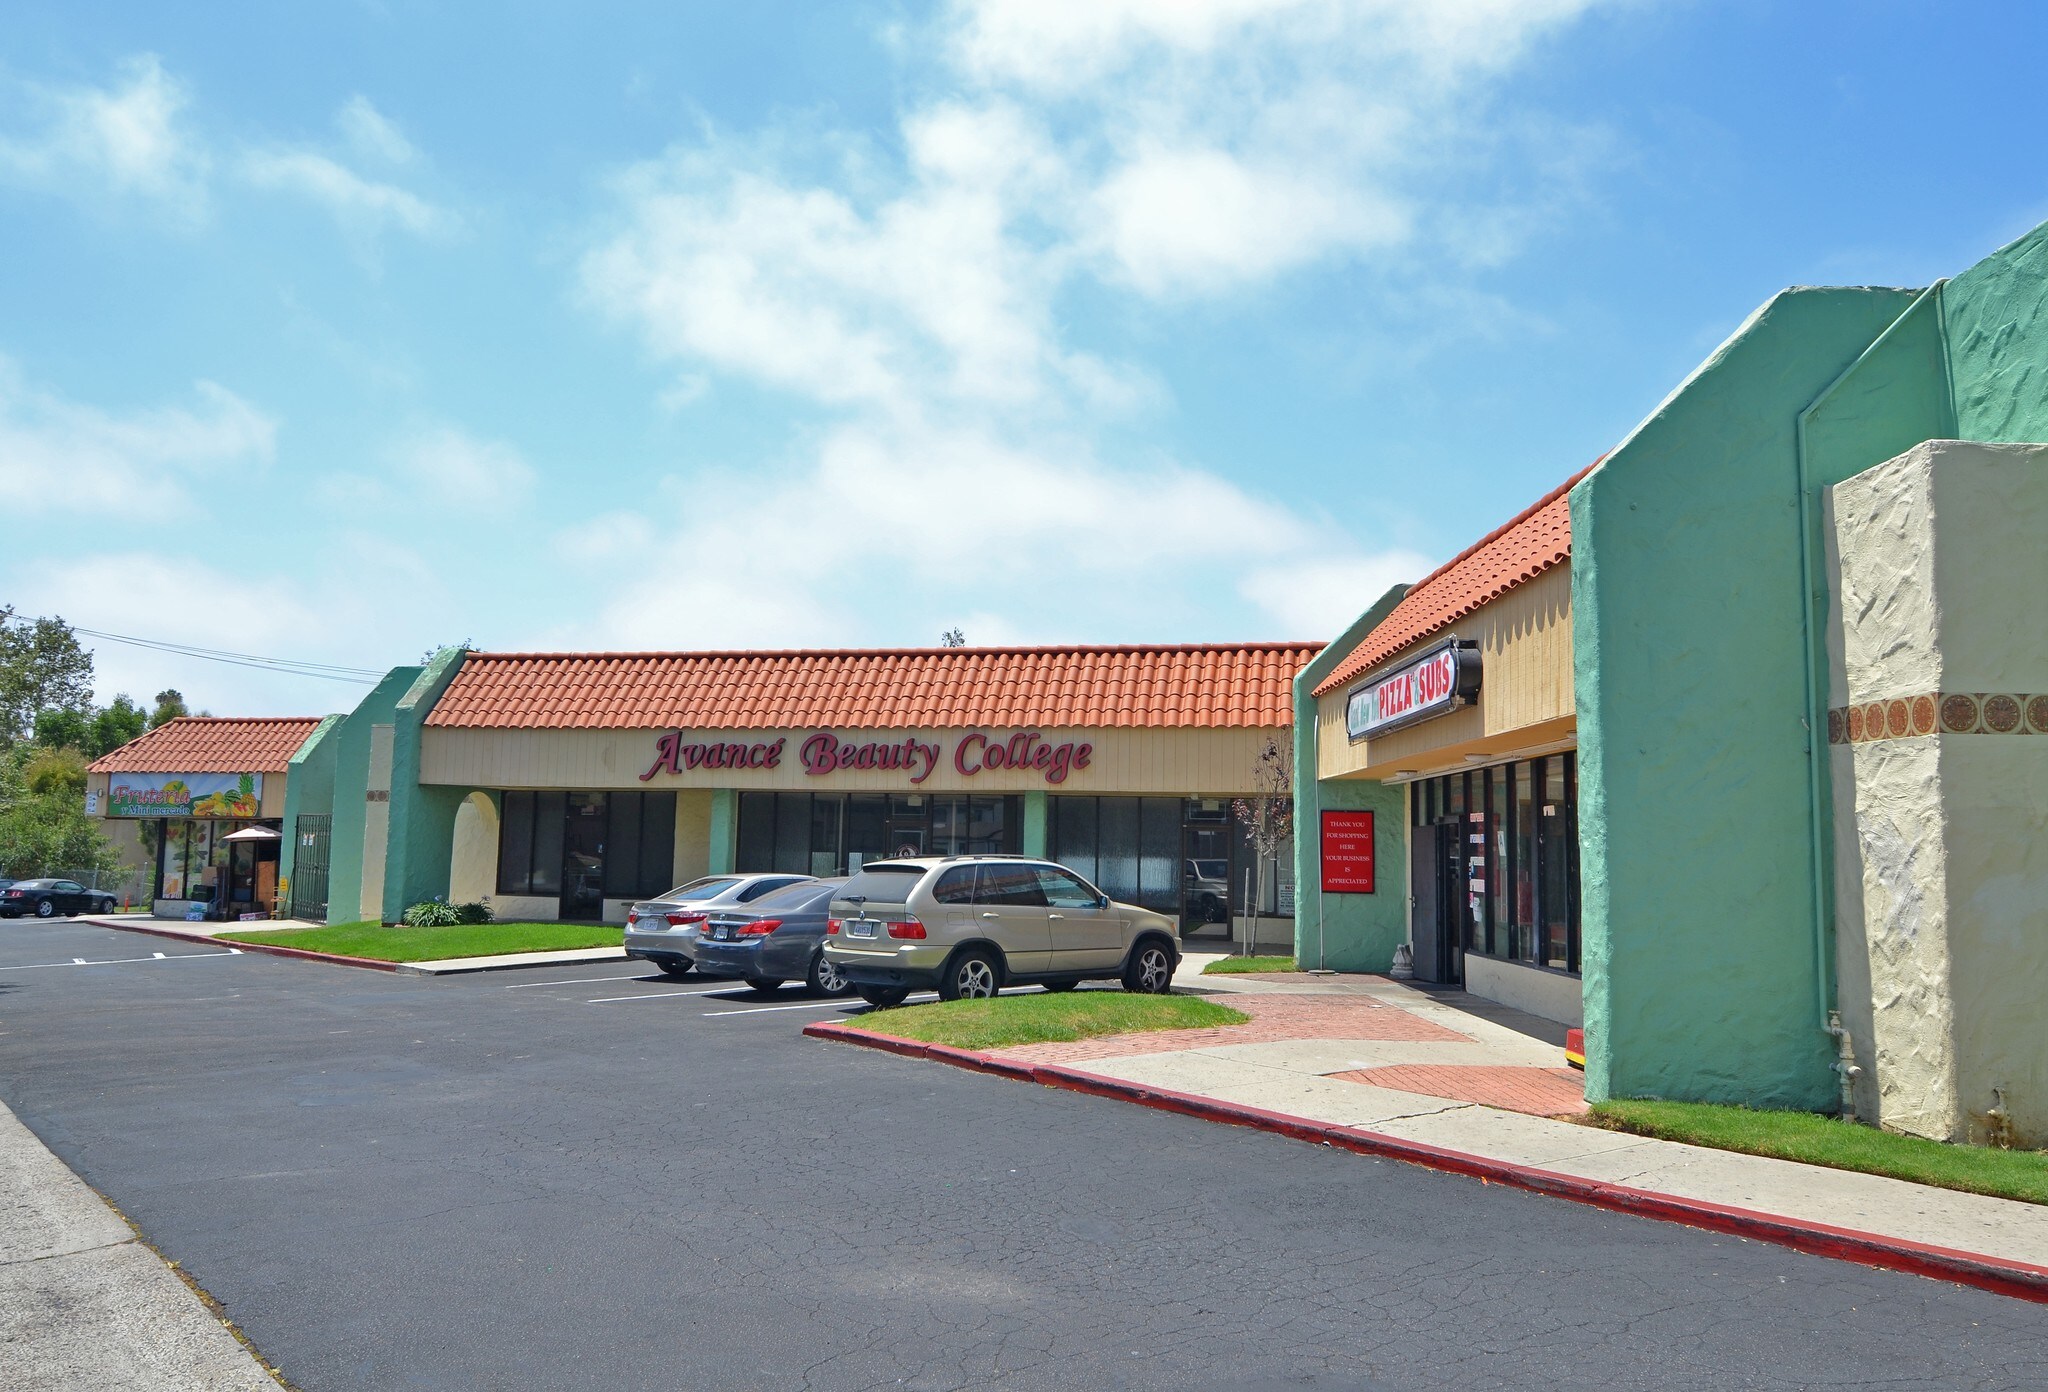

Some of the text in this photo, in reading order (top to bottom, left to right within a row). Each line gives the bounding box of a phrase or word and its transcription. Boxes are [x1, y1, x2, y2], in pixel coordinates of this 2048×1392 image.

[1379, 674, 1412, 720] PIZZA
[1418, 654, 1451, 705] SUBS
[639, 731, 1093, 784] Avancé Beauty College
[129, 804, 151, 816] Mini
[151, 804, 191, 816] mercado
